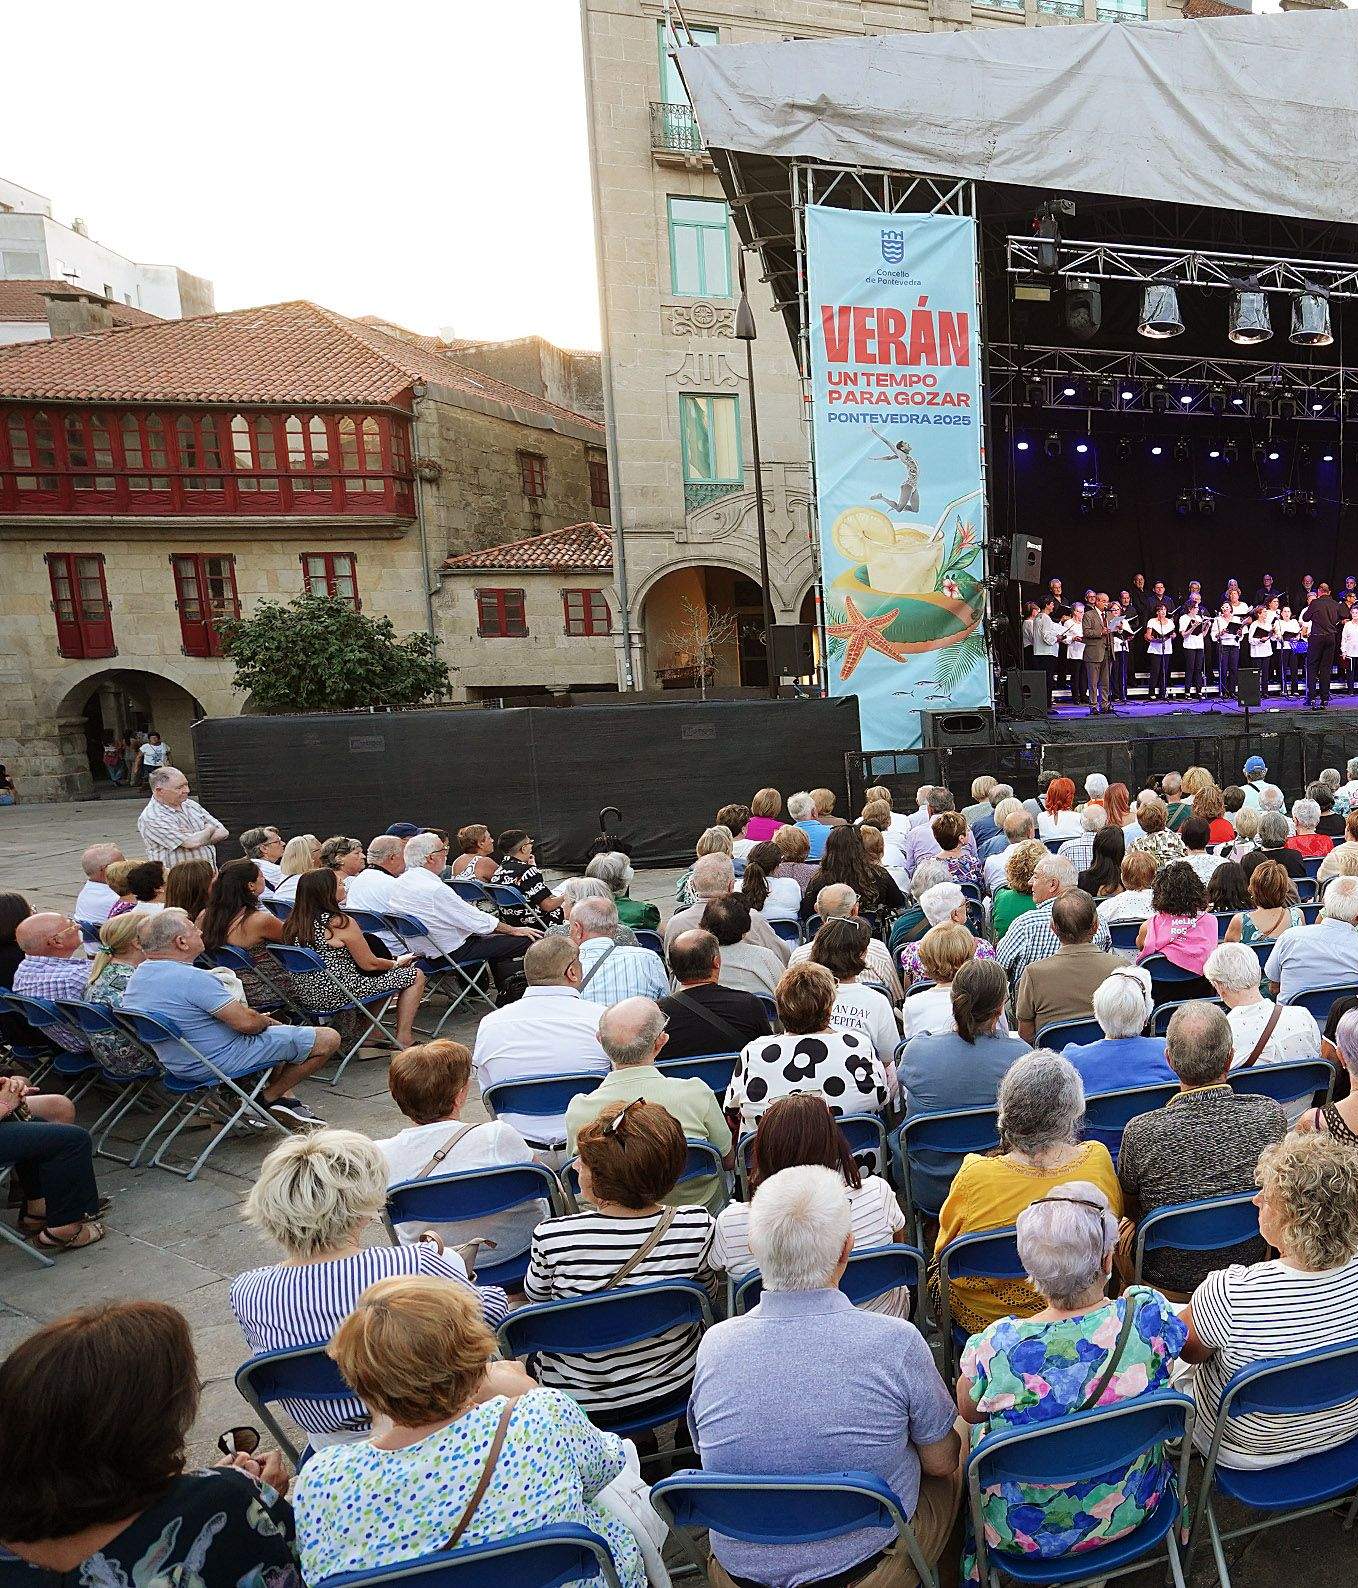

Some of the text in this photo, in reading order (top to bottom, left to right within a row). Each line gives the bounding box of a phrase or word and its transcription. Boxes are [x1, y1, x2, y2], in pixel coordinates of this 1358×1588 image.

[876, 268, 910, 278] Concello
[865, 276, 922, 286] de Pontevedra
[820, 295, 970, 367] VERÁN
[827, 371, 938, 388] UN TEMPO
[828, 390, 971, 408] PARA GOZAR
[827, 412, 972, 426] PONTEVEDRA 2025
[850, 1006, 871, 1019] DAY
